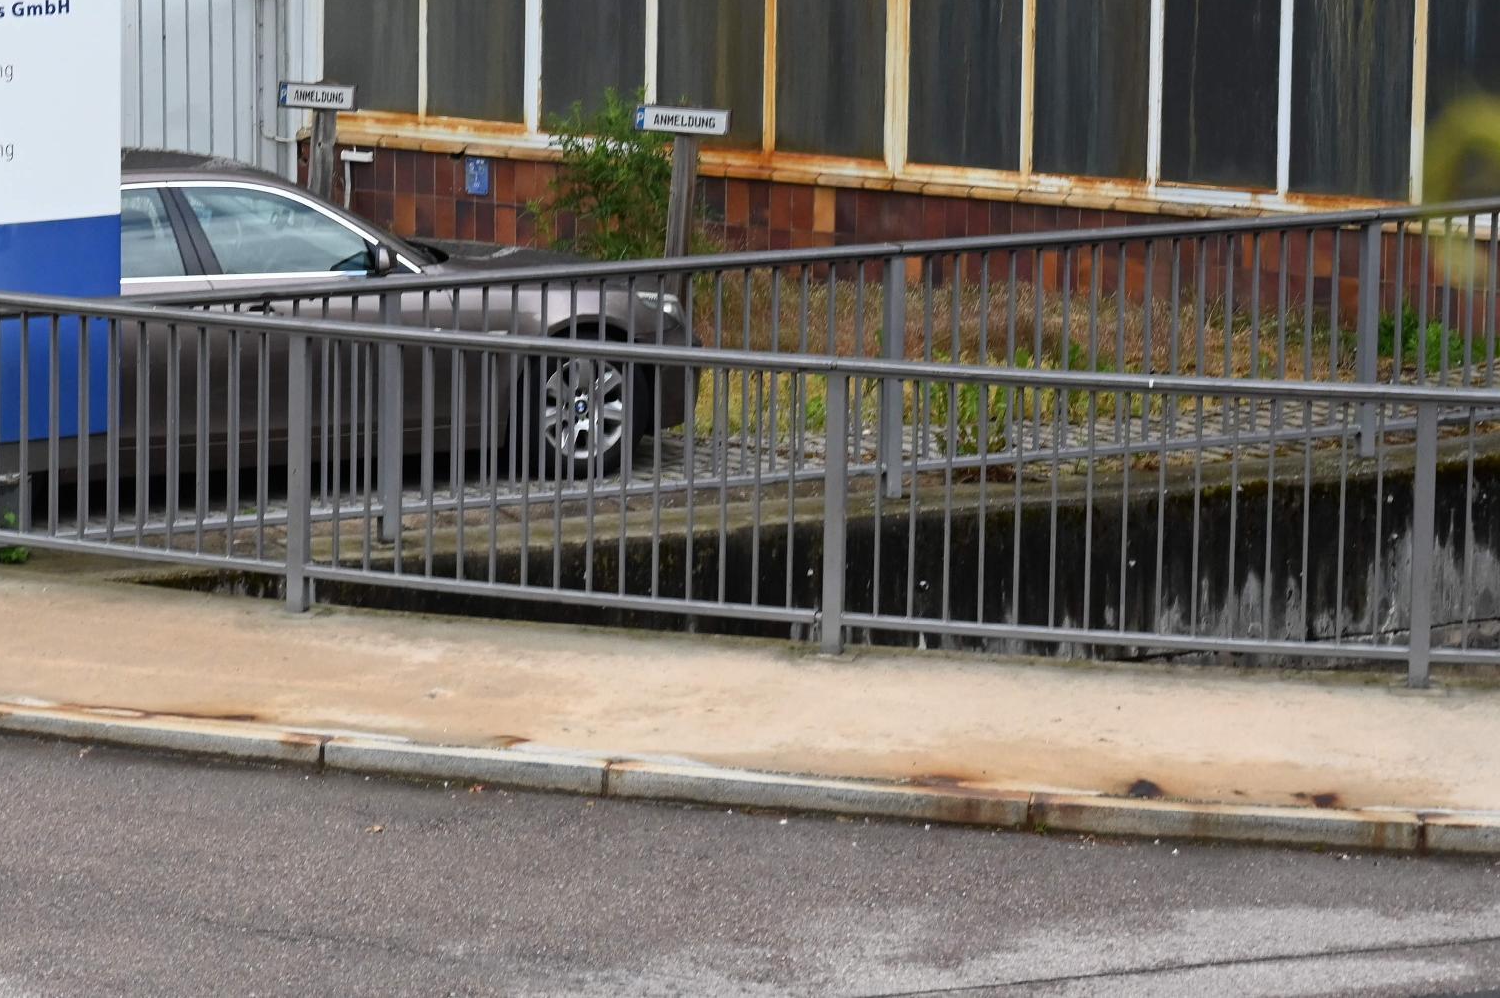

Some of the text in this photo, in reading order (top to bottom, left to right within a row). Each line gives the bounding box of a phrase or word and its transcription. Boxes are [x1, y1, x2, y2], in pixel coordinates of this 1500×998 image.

[12, 0, 70, 17] GmbH
[294, 89, 344, 104] ANMELDUNG
[653, 114, 716, 129] ANMELDUNG
